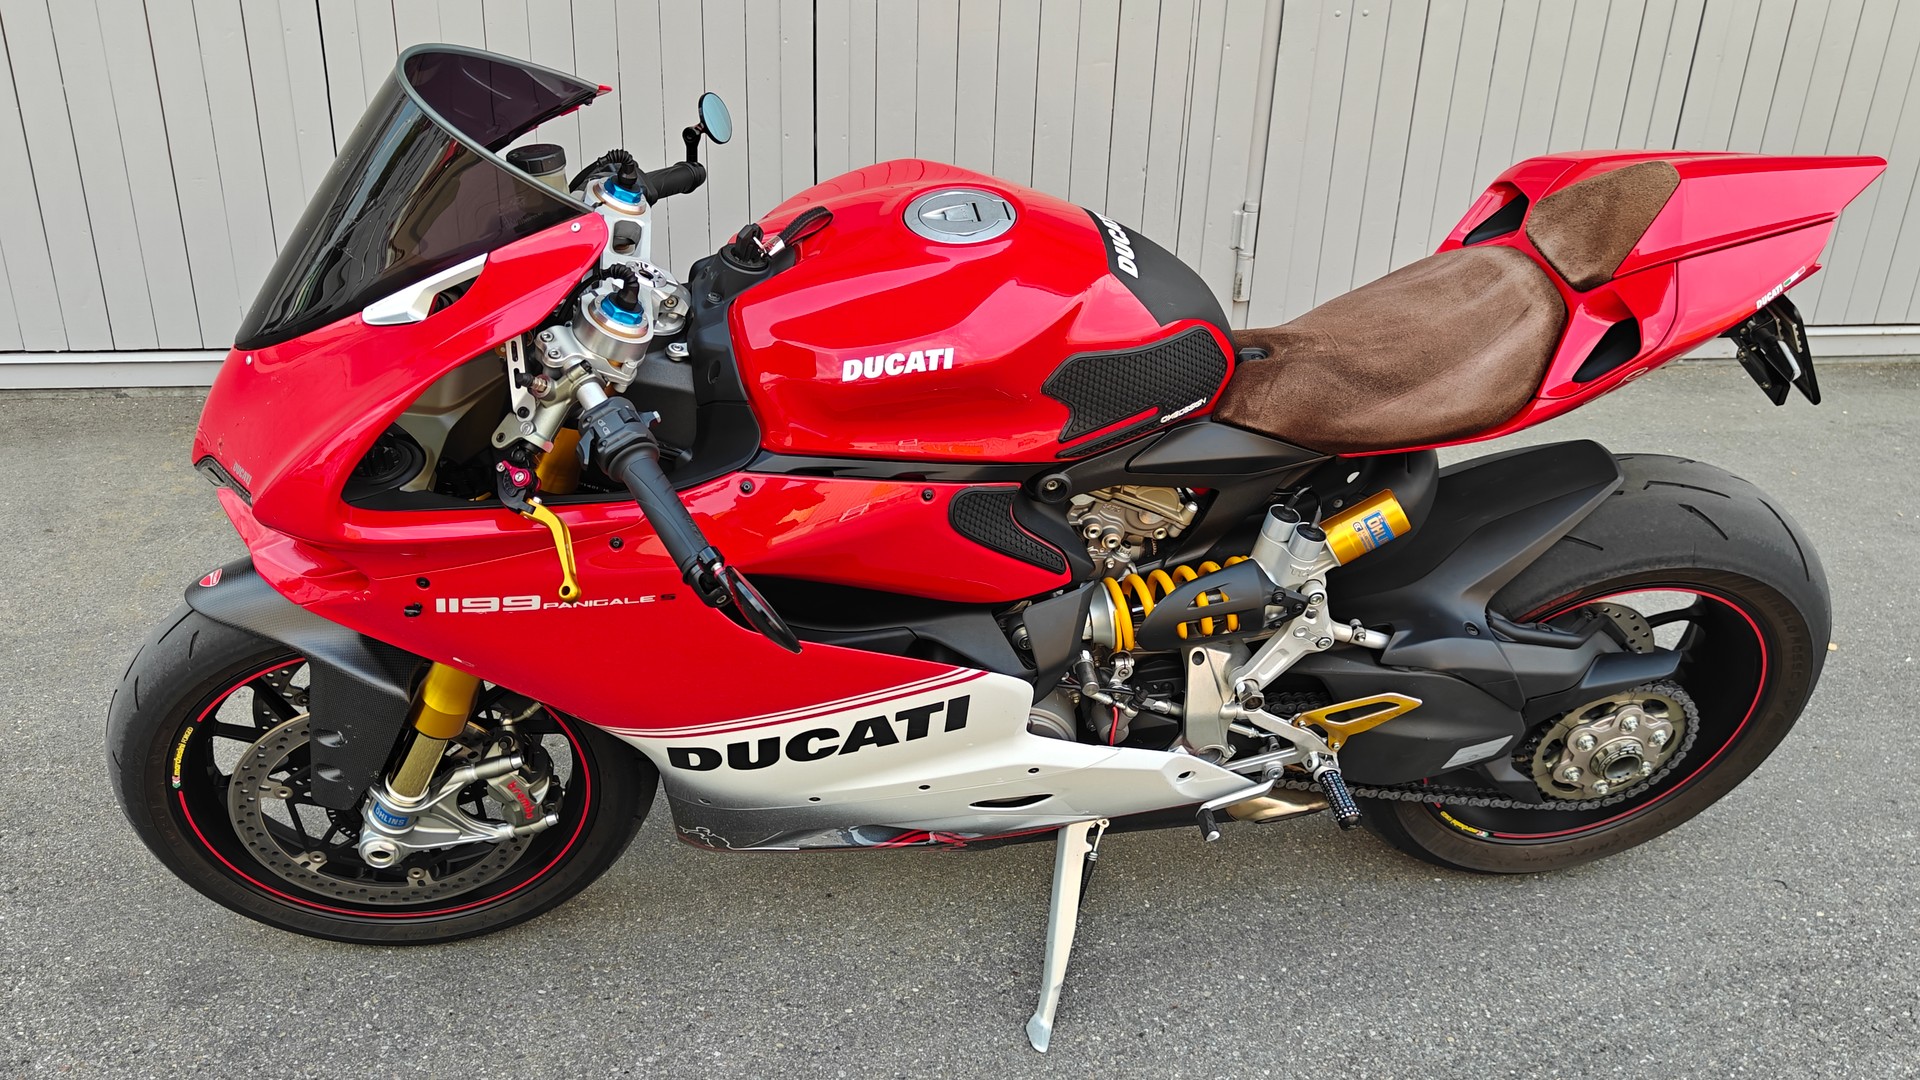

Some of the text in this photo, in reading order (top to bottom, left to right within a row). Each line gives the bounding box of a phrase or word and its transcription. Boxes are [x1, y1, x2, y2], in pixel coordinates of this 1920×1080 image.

[1094, 211, 1139, 279] DUCA
[1756, 283, 1783, 310] DUCATI
[841, 347, 955, 383] DUCATI
[435, 595, 542, 614] 1199
[543, 595, 656, 610] PANIGALE
[666, 694, 971, 772] DUCATI
[375, 804, 406, 827] ÖHLINS
[507, 780, 535, 820] brembo
